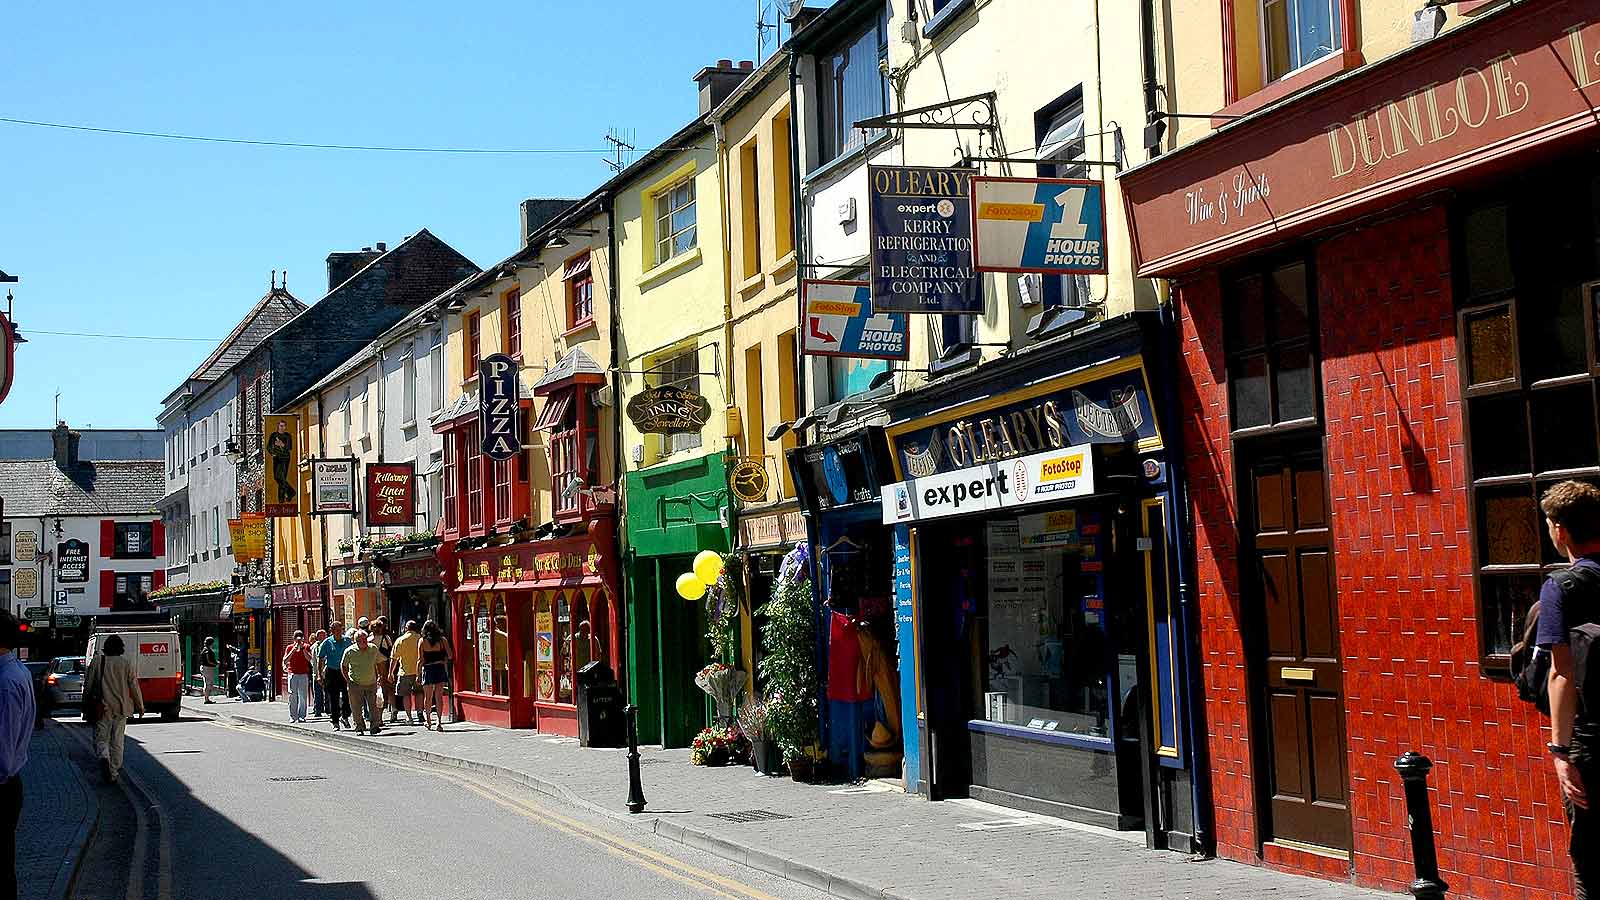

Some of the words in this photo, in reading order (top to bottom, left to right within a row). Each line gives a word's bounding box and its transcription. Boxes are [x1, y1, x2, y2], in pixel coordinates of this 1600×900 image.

[1325, 51, 1529, 178] DUNLOE
[1185, 188, 1214, 224] Wine
[1219, 182, 1228, 224] &
[1233, 171, 1270, 217] Spirits
[897, 203, 937, 215] expert
[985, 205, 1039, 219] FotoStop
[1050, 187, 1088, 239] 1
[903, 219, 953, 234] KERRY
[1046, 239, 1100, 254] HOUR
[918, 254, 937, 263] AND
[1044, 254, 1100, 266] PHOTOS
[881, 265, 975, 279] ELECTRICAL
[892, 281, 963, 294] COMPANY
[815, 303, 857, 314] FotoStop
[861, 330, 903, 343] HOUR
[858, 342, 903, 352] PHOTOS
[489, 361, 513, 454] PIZZA
[644, 417, 691, 430] Jewellers
[948, 400, 1064, 467] O'LEARYS
[1043, 460, 1081, 477] FotoStop
[375, 472, 409, 485] Killarney
[377, 485, 405, 497] Linen
[854, 487, 872, 501] Crafts
[924, 469, 1009, 508] expert
[387, 497, 394, 505] &
[378, 504, 403, 516] Lace
[59, 591, 66, 600] P
[152, 643, 167, 653] GA
